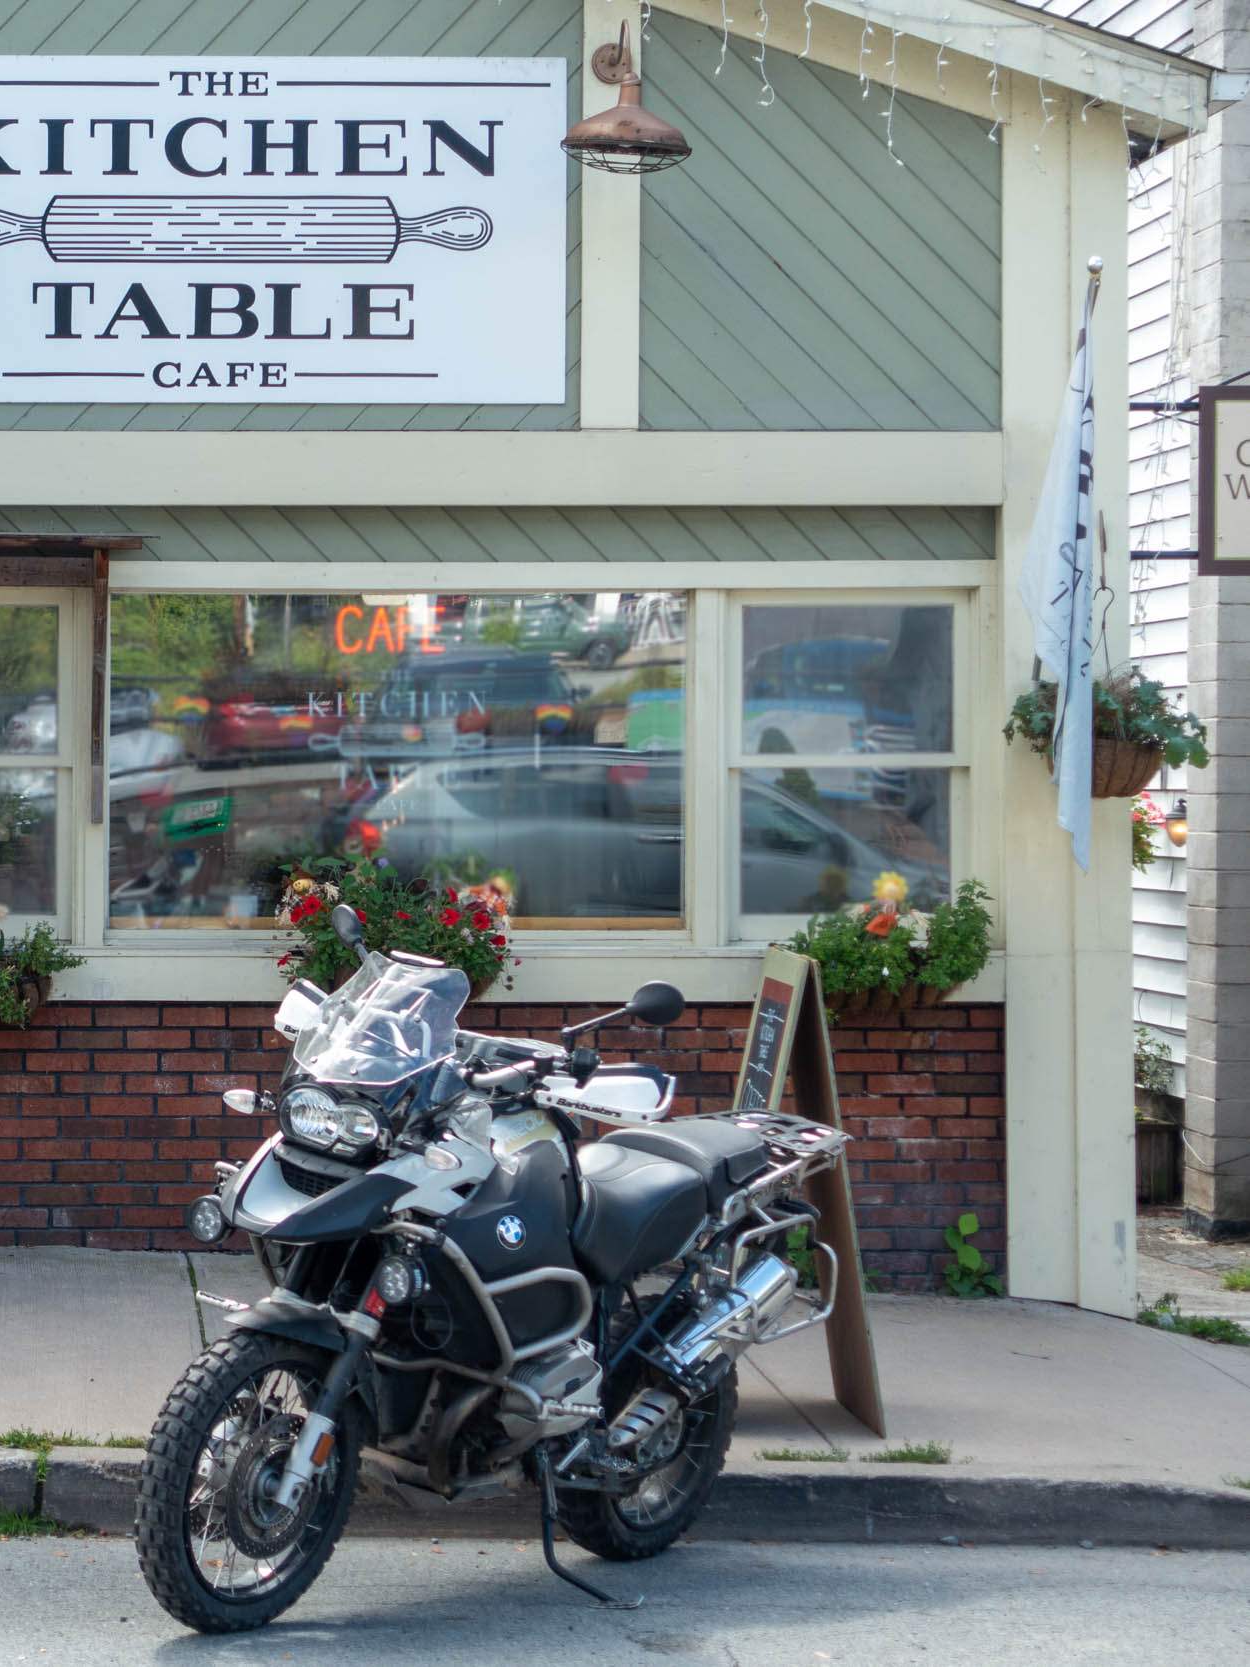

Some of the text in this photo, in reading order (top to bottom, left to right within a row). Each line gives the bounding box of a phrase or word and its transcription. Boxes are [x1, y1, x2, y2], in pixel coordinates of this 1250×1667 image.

[169, 71, 269, 97] THE
[32, 283, 415, 340] TABLE
[152, 362, 288, 388] CAFE
[335, 605, 446, 654] CAFE
[306, 691, 487, 717] KITCHEN
[556, 1097, 622, 1118] Barkbusters
